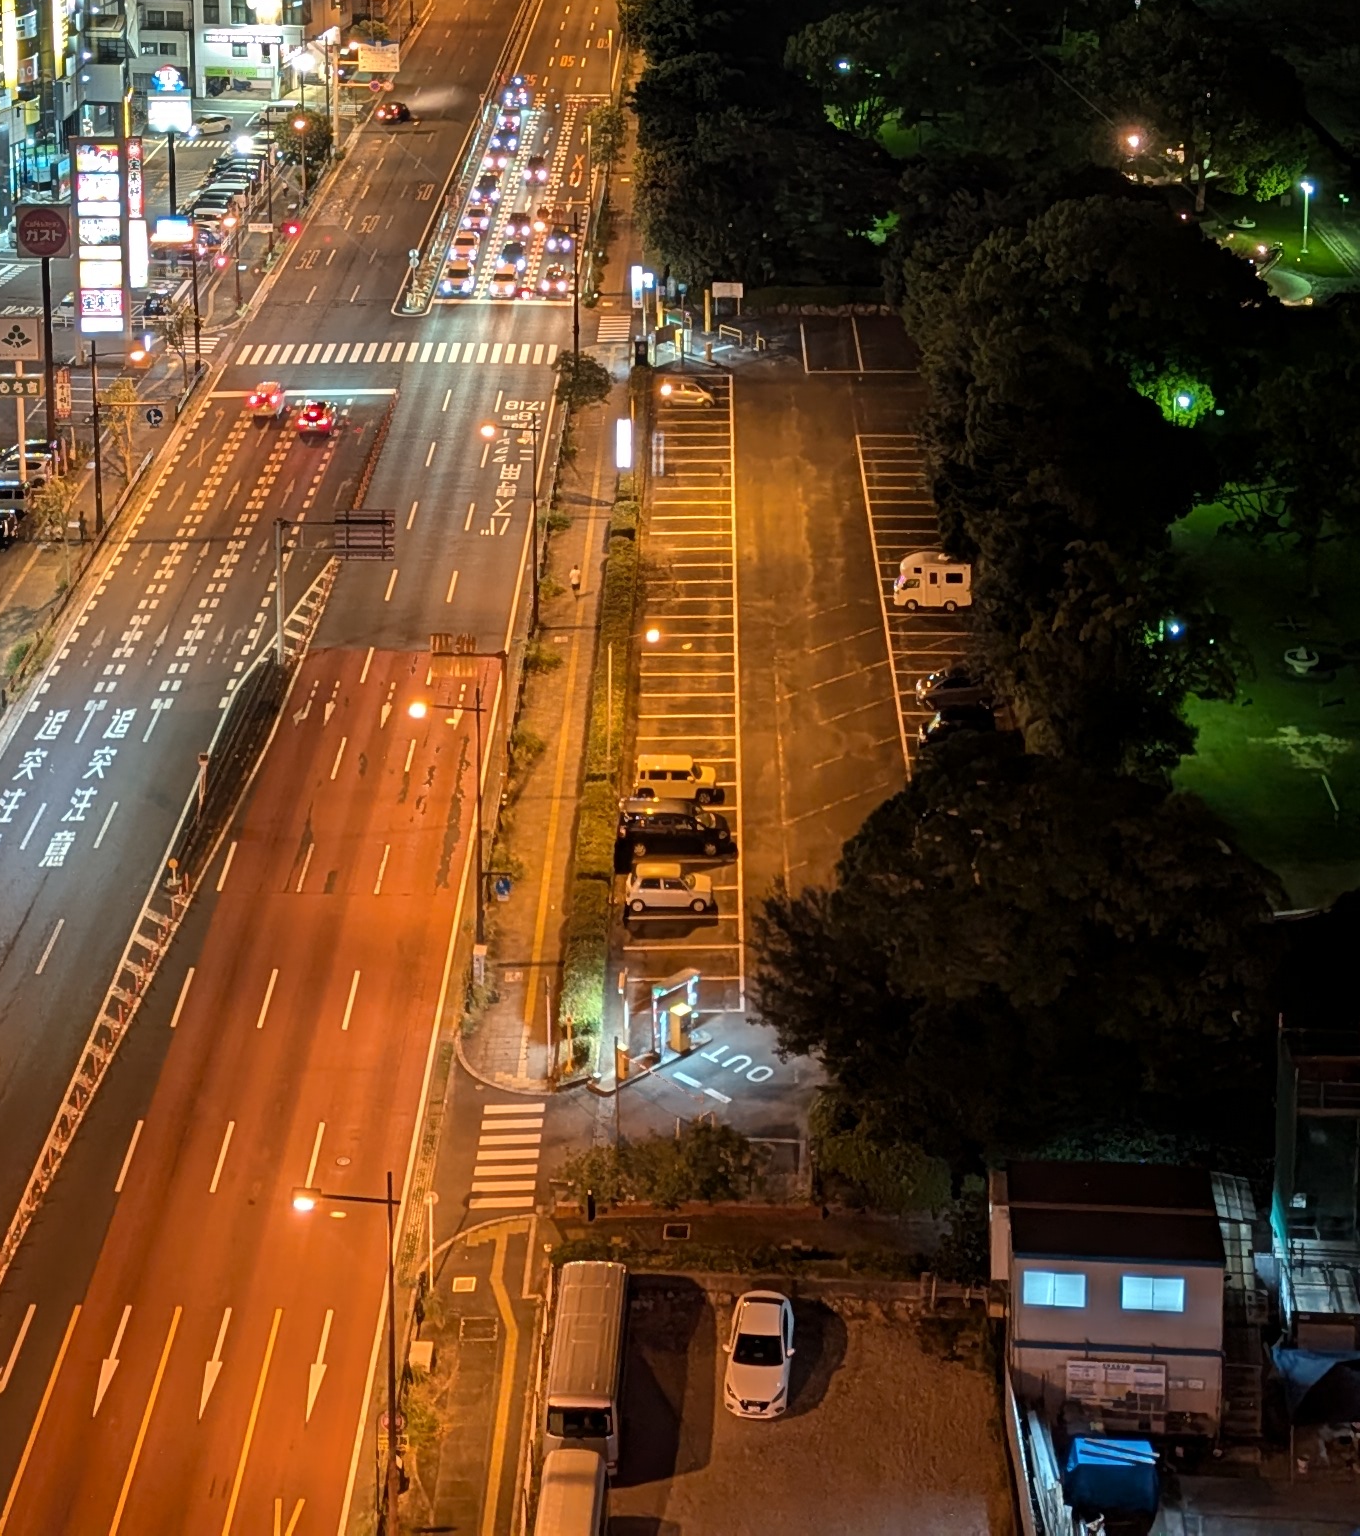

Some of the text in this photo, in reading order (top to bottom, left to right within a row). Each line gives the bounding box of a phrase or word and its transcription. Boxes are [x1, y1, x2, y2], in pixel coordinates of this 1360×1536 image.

[415, 183, 436, 201] 50
[357, 215, 381, 233] 50
[25, 229, 63, 243] ガスト
[294, 249, 322, 270] 50
[479, 463, 522, 536] バス専用
[37, 707, 138, 868] 追突注意
[700, 1044, 775, 1083] OUT
